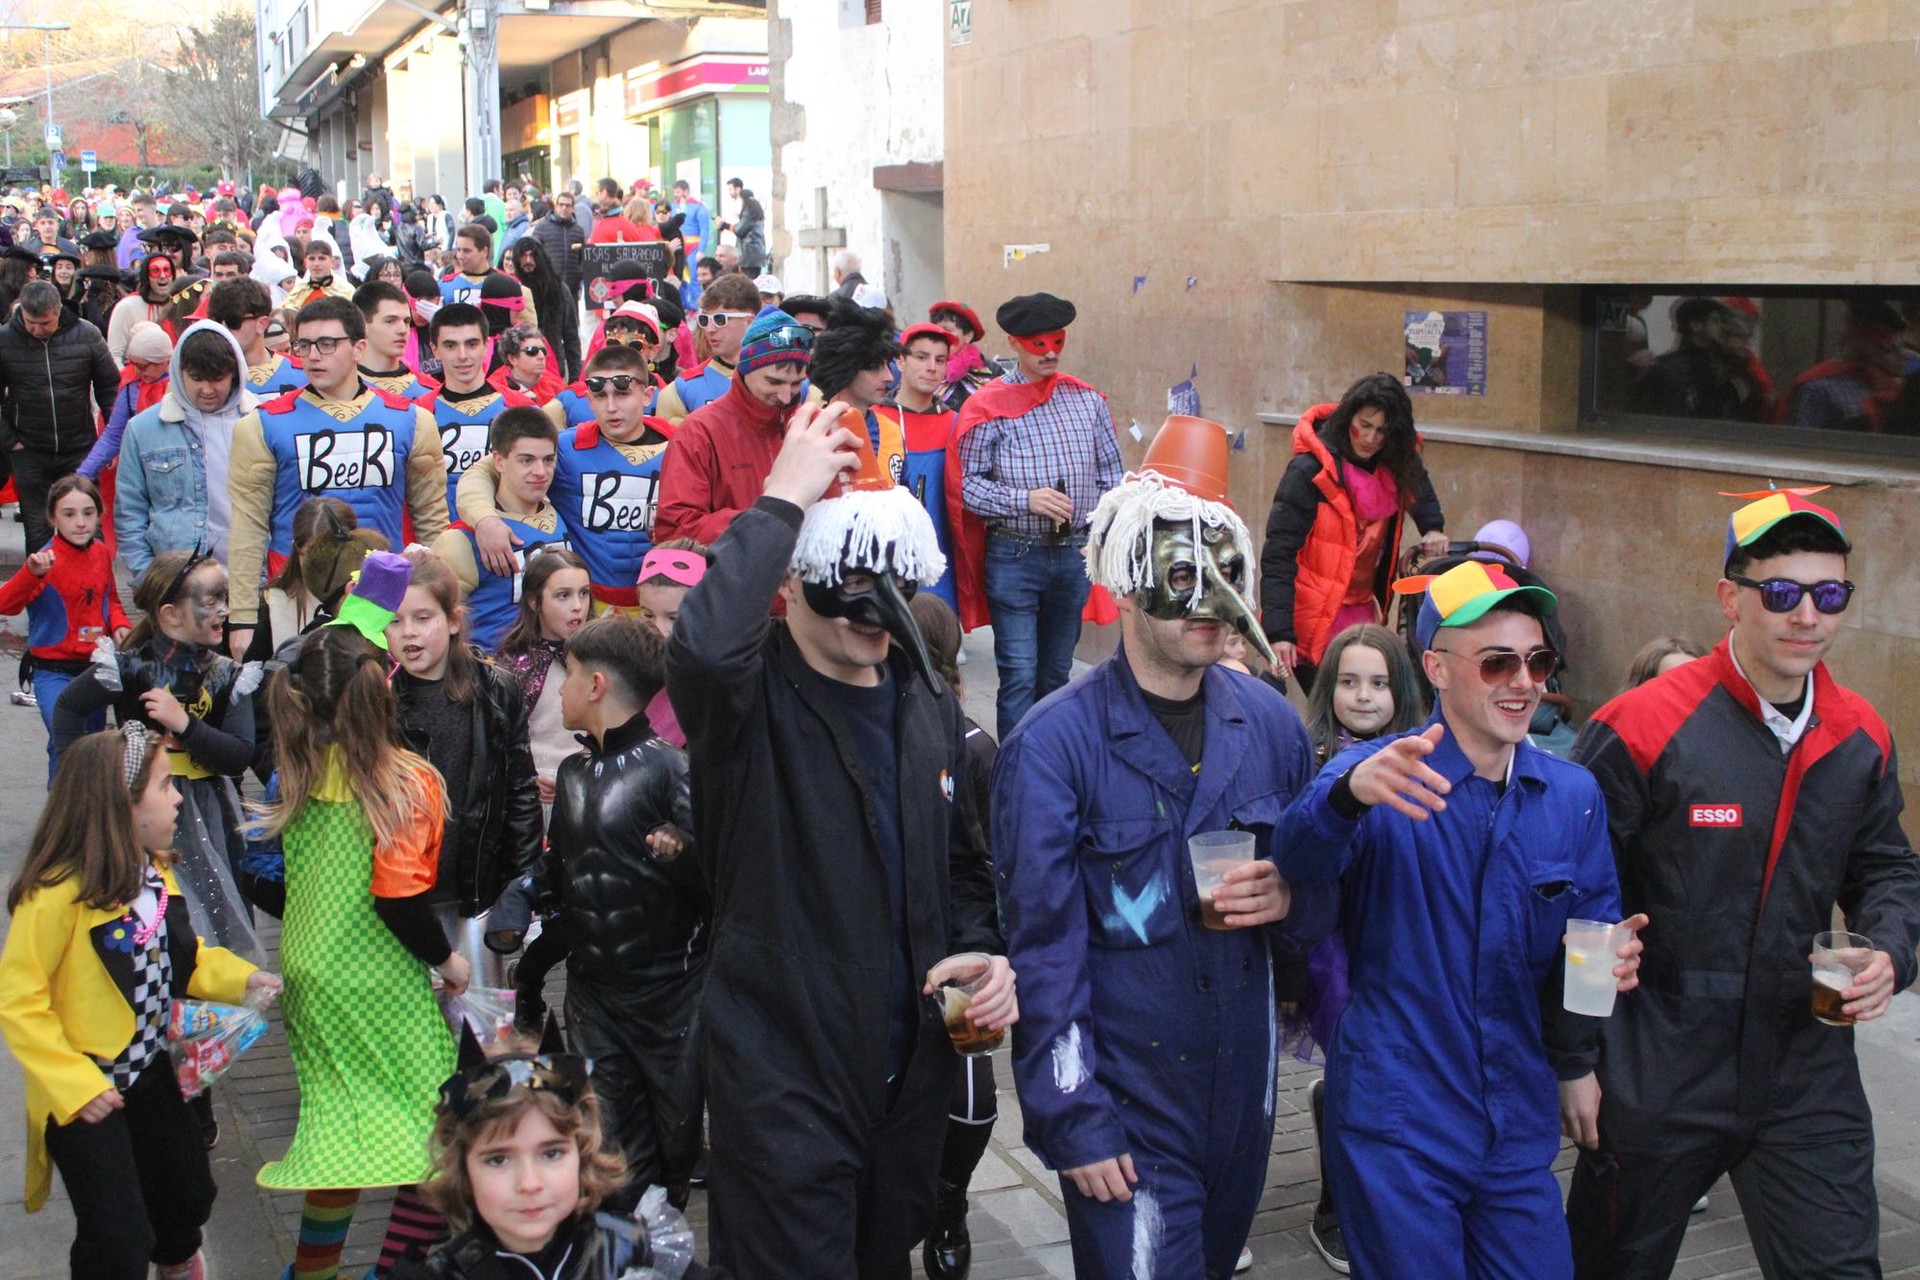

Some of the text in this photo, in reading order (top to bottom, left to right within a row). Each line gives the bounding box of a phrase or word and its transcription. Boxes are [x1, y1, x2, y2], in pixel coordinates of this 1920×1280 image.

[748, 67, 769, 76] LAB
[584, 247, 610, 262] ITSAS
[306, 422, 388, 496] BeeR
[1693, 809, 1738, 823] ESSO
